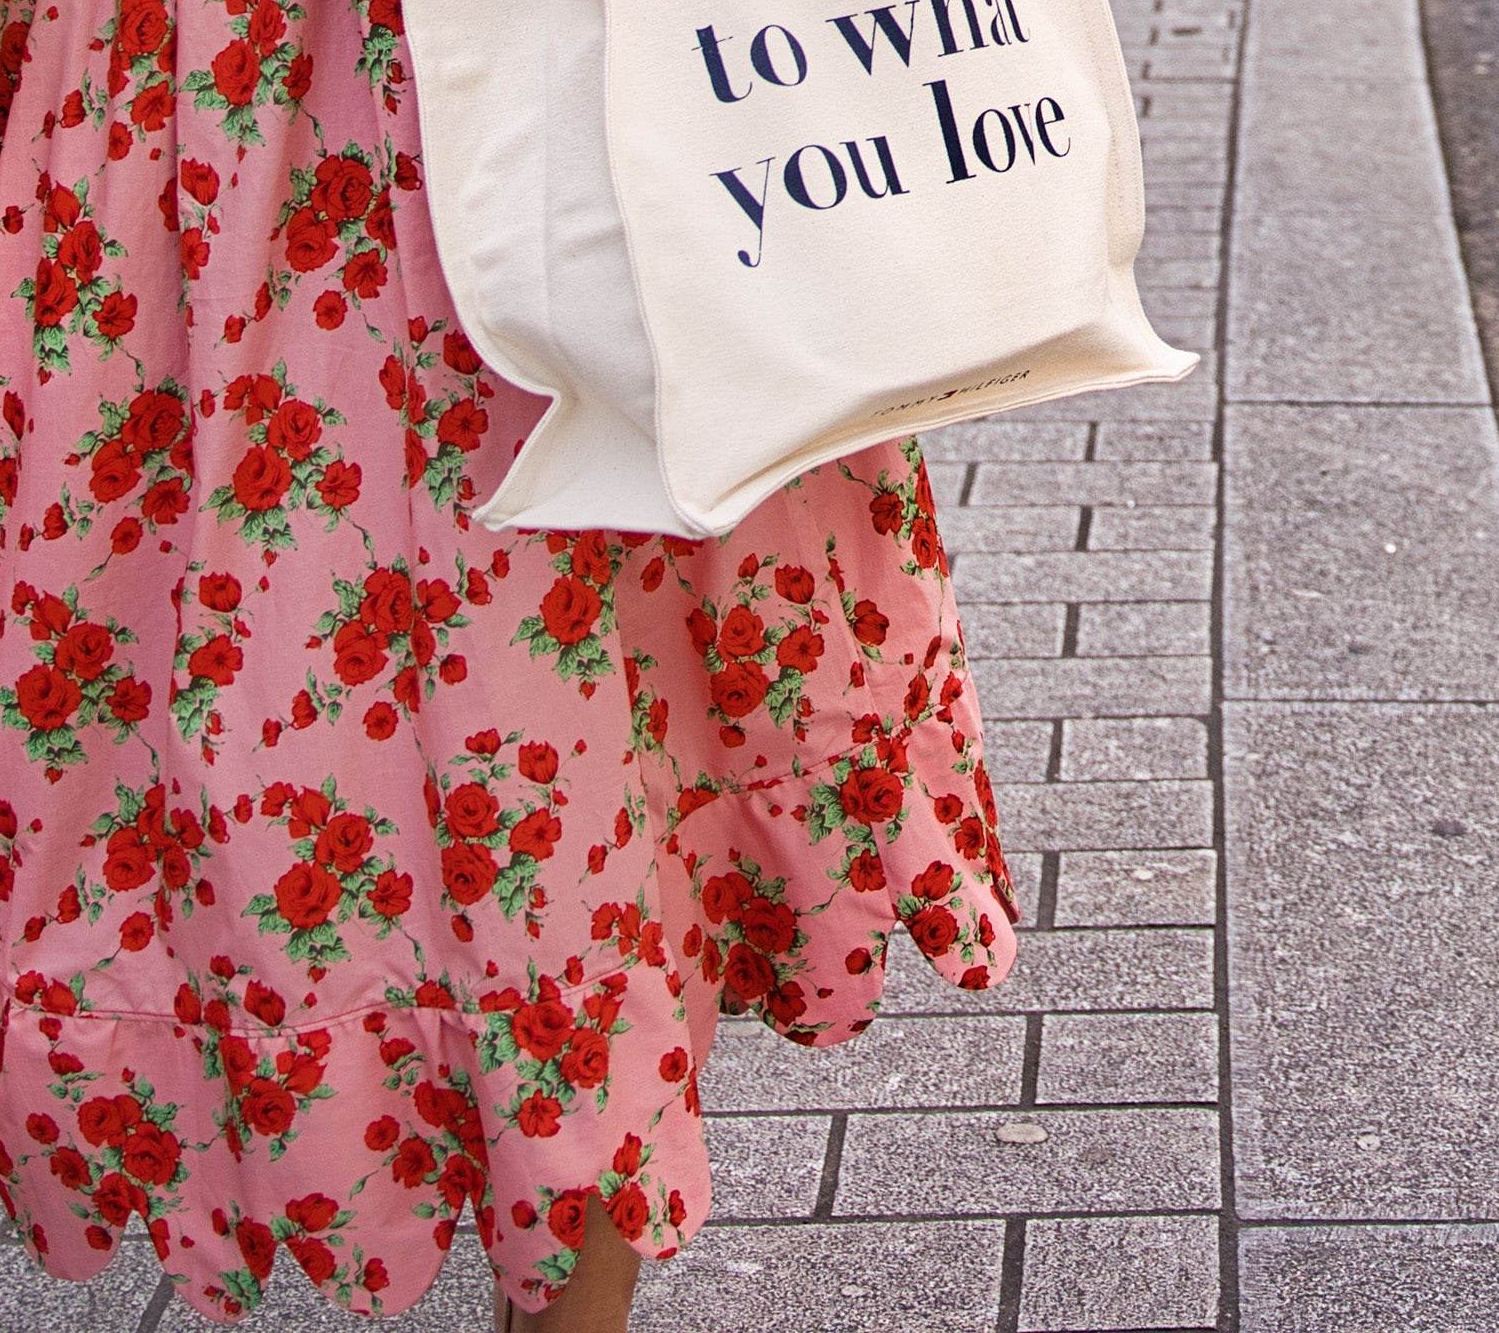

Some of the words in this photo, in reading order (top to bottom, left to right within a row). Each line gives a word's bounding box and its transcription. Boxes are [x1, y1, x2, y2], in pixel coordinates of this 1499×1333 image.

[691, 24, 807, 103] to
[710, 136, 910, 267] you
[923, 80, 1071, 185] love
[958, 370, 1030, 395] HILFIGER
